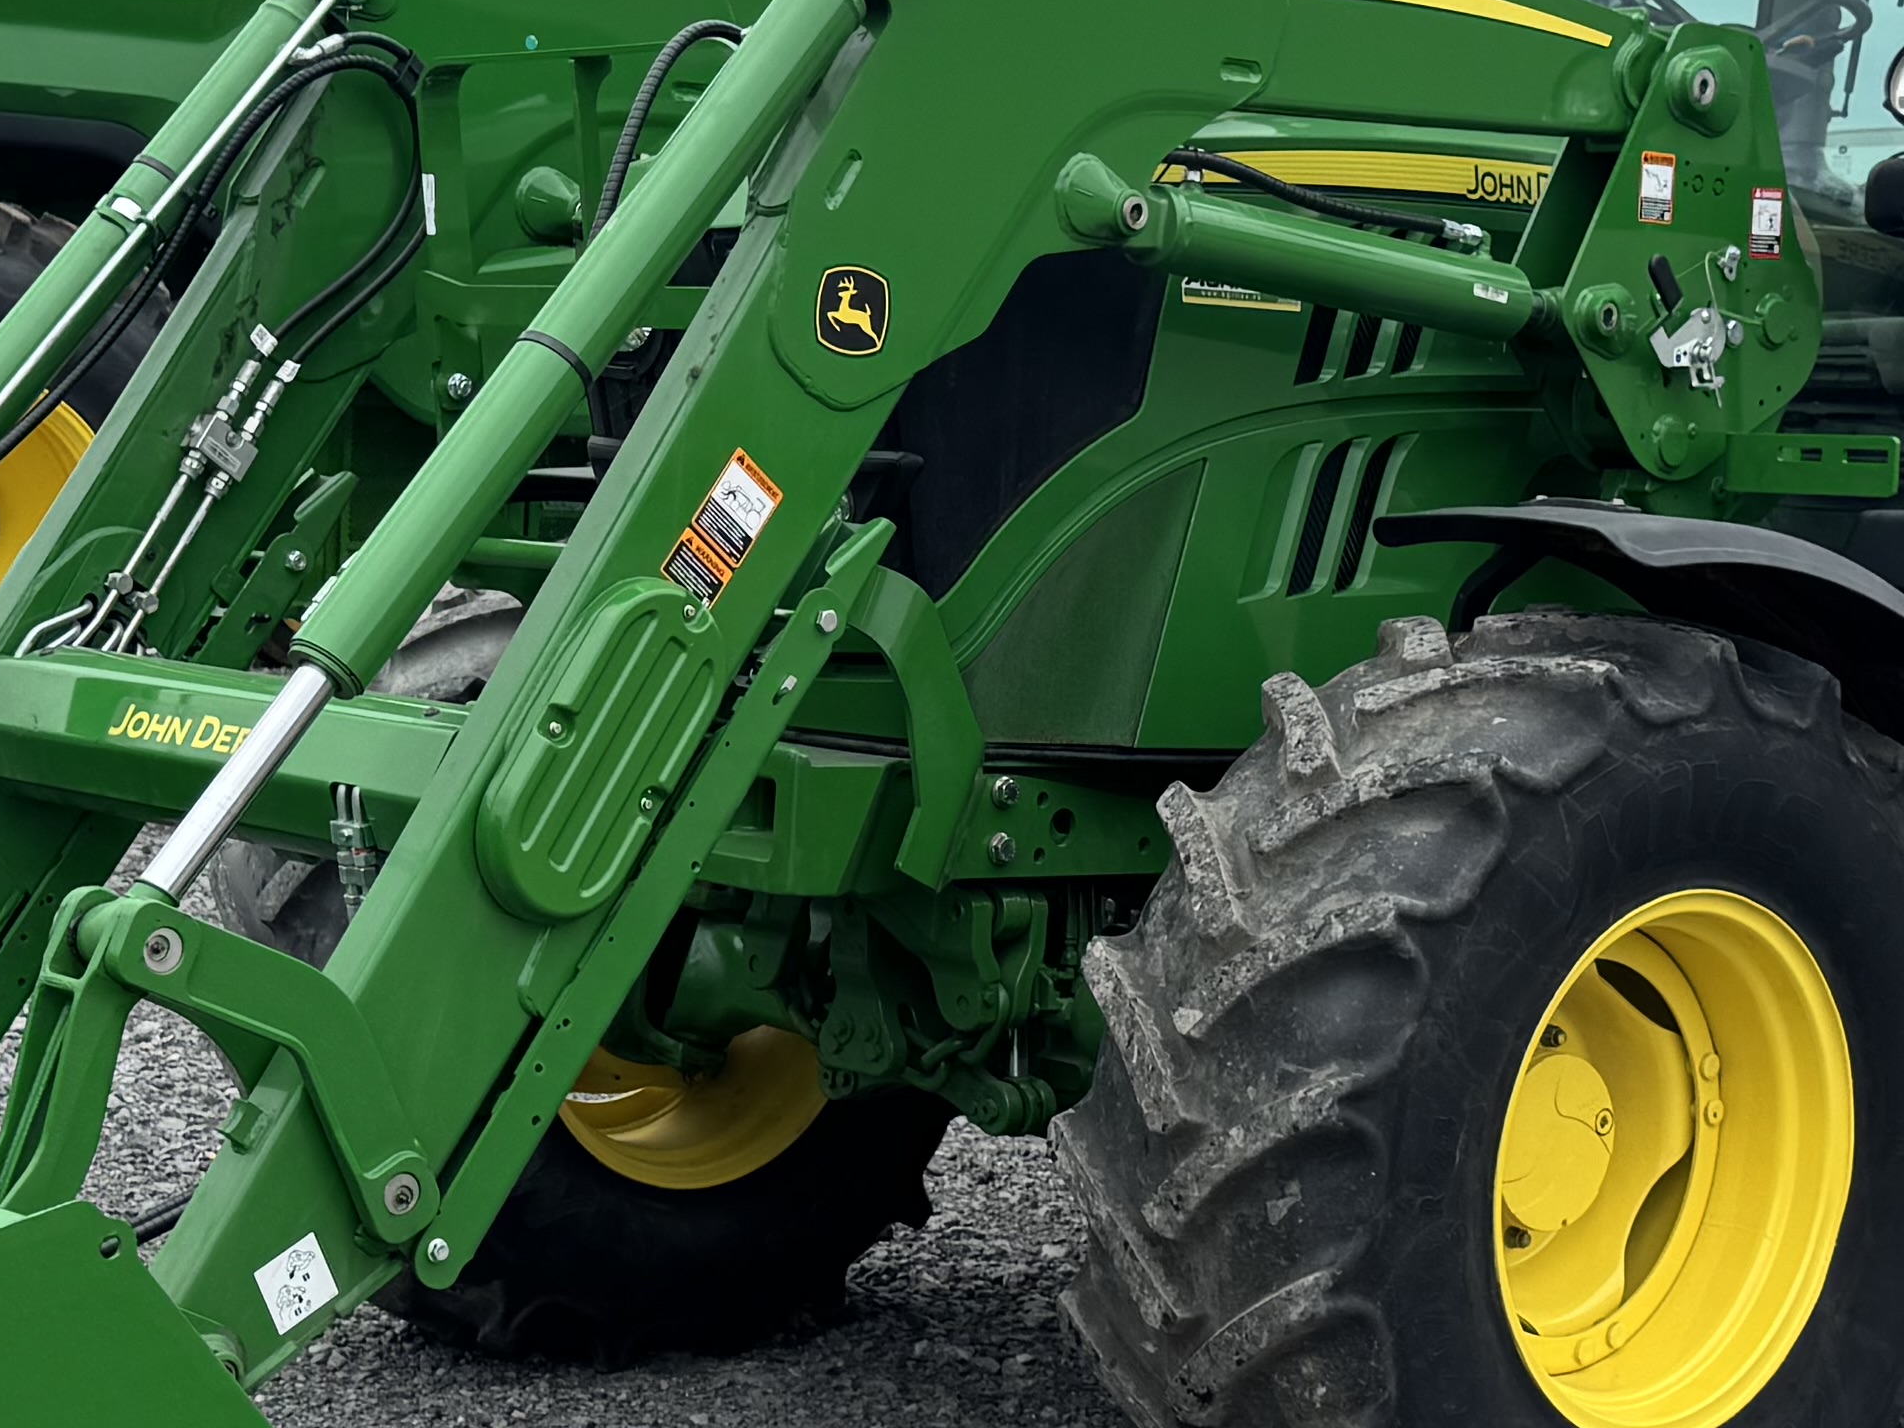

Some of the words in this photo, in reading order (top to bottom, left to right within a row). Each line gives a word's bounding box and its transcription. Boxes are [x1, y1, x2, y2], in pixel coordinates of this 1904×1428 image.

[1466, 164, 1532, 200] JOHN
[107, 703, 193, 746] JOHN
[191, 714, 253, 754] DEE
